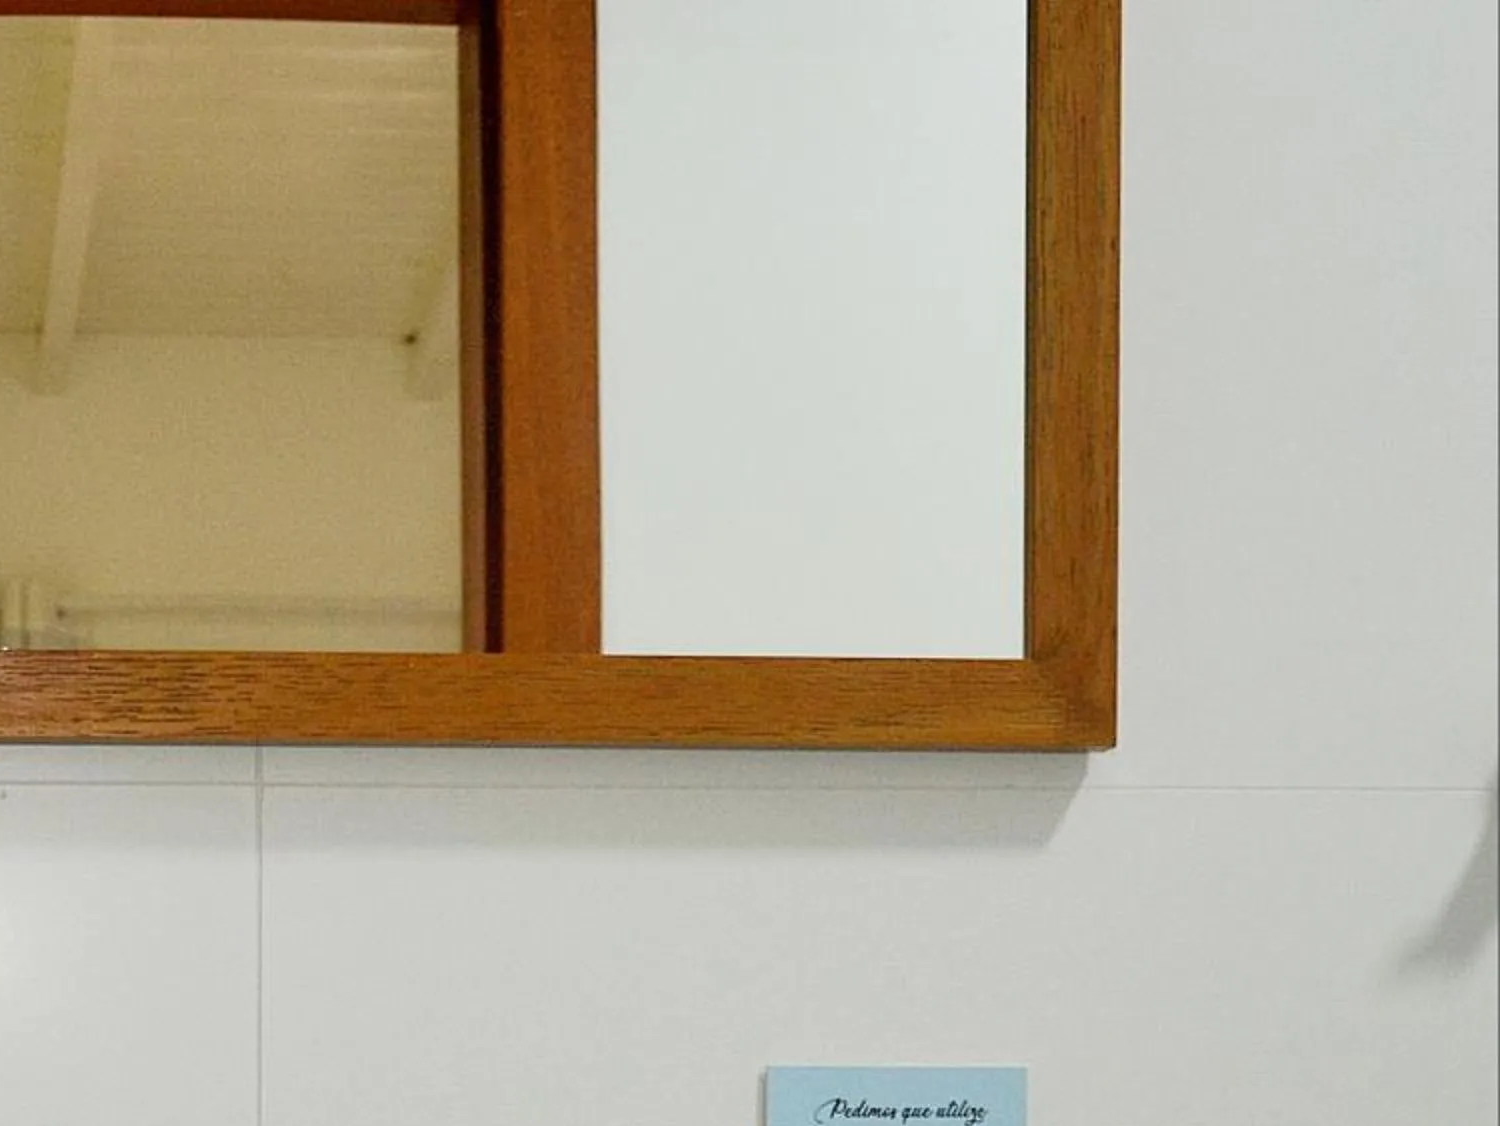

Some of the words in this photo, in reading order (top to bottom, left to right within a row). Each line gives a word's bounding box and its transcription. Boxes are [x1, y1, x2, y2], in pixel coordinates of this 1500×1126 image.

[814, 1098, 896, 1124] Pedimos
[901, 1105, 933, 1124] que
[935, 1100, 988, 1126] utilize
